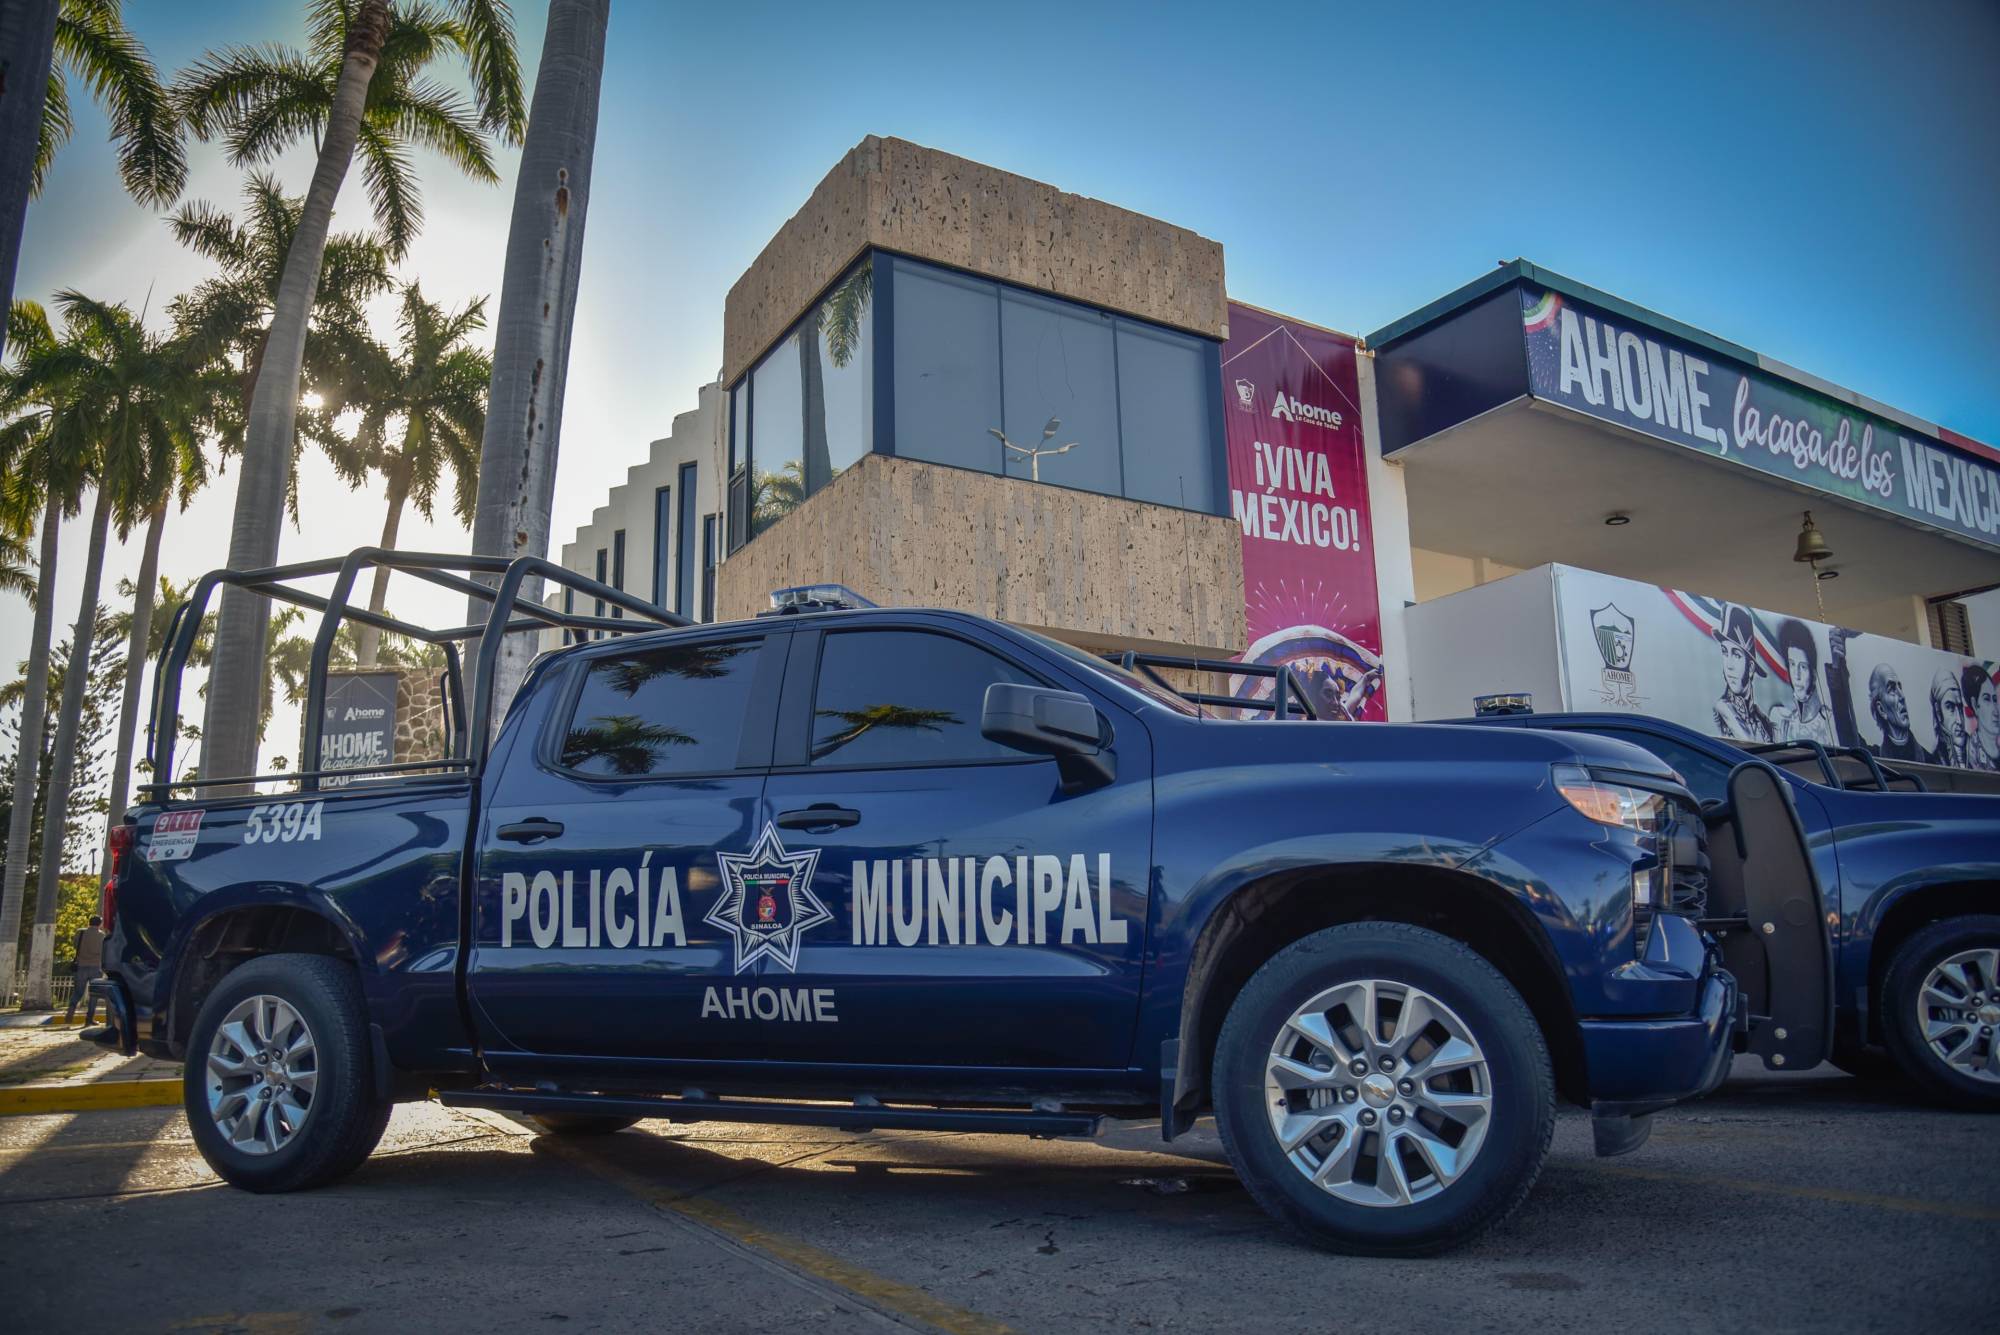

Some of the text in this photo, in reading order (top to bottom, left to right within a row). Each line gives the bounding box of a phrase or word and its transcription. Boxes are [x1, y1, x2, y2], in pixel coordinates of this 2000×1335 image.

[1271, 391, 1343, 423] Ahome
[1560, 307, 1728, 456] AHOME,
[1733, 376, 1768, 449] la
[1768, 413, 1829, 469] casa
[1828, 418, 1861, 480] de
[1860, 424, 1896, 497] los
[1254, 441, 1336, 499] ¡VIVA
[1232, 487, 1360, 552] MÉXICO!
[1606, 671, 1631, 682] AHOME
[343, 707, 385, 721] Ahome
[320, 731, 388, 758] AHOME,
[158, 812, 198, 831] 911
[244, 802, 324, 844] 539A
[151, 837, 196, 847] EMERGENCIAS
[763, 872, 791, 880] MUNICIPAL
[502, 851, 1128, 949] POLICÍA MUNICIPAL
[751, 922, 783, 930] SINALOA
[701, 986, 839, 1022] AHOME
